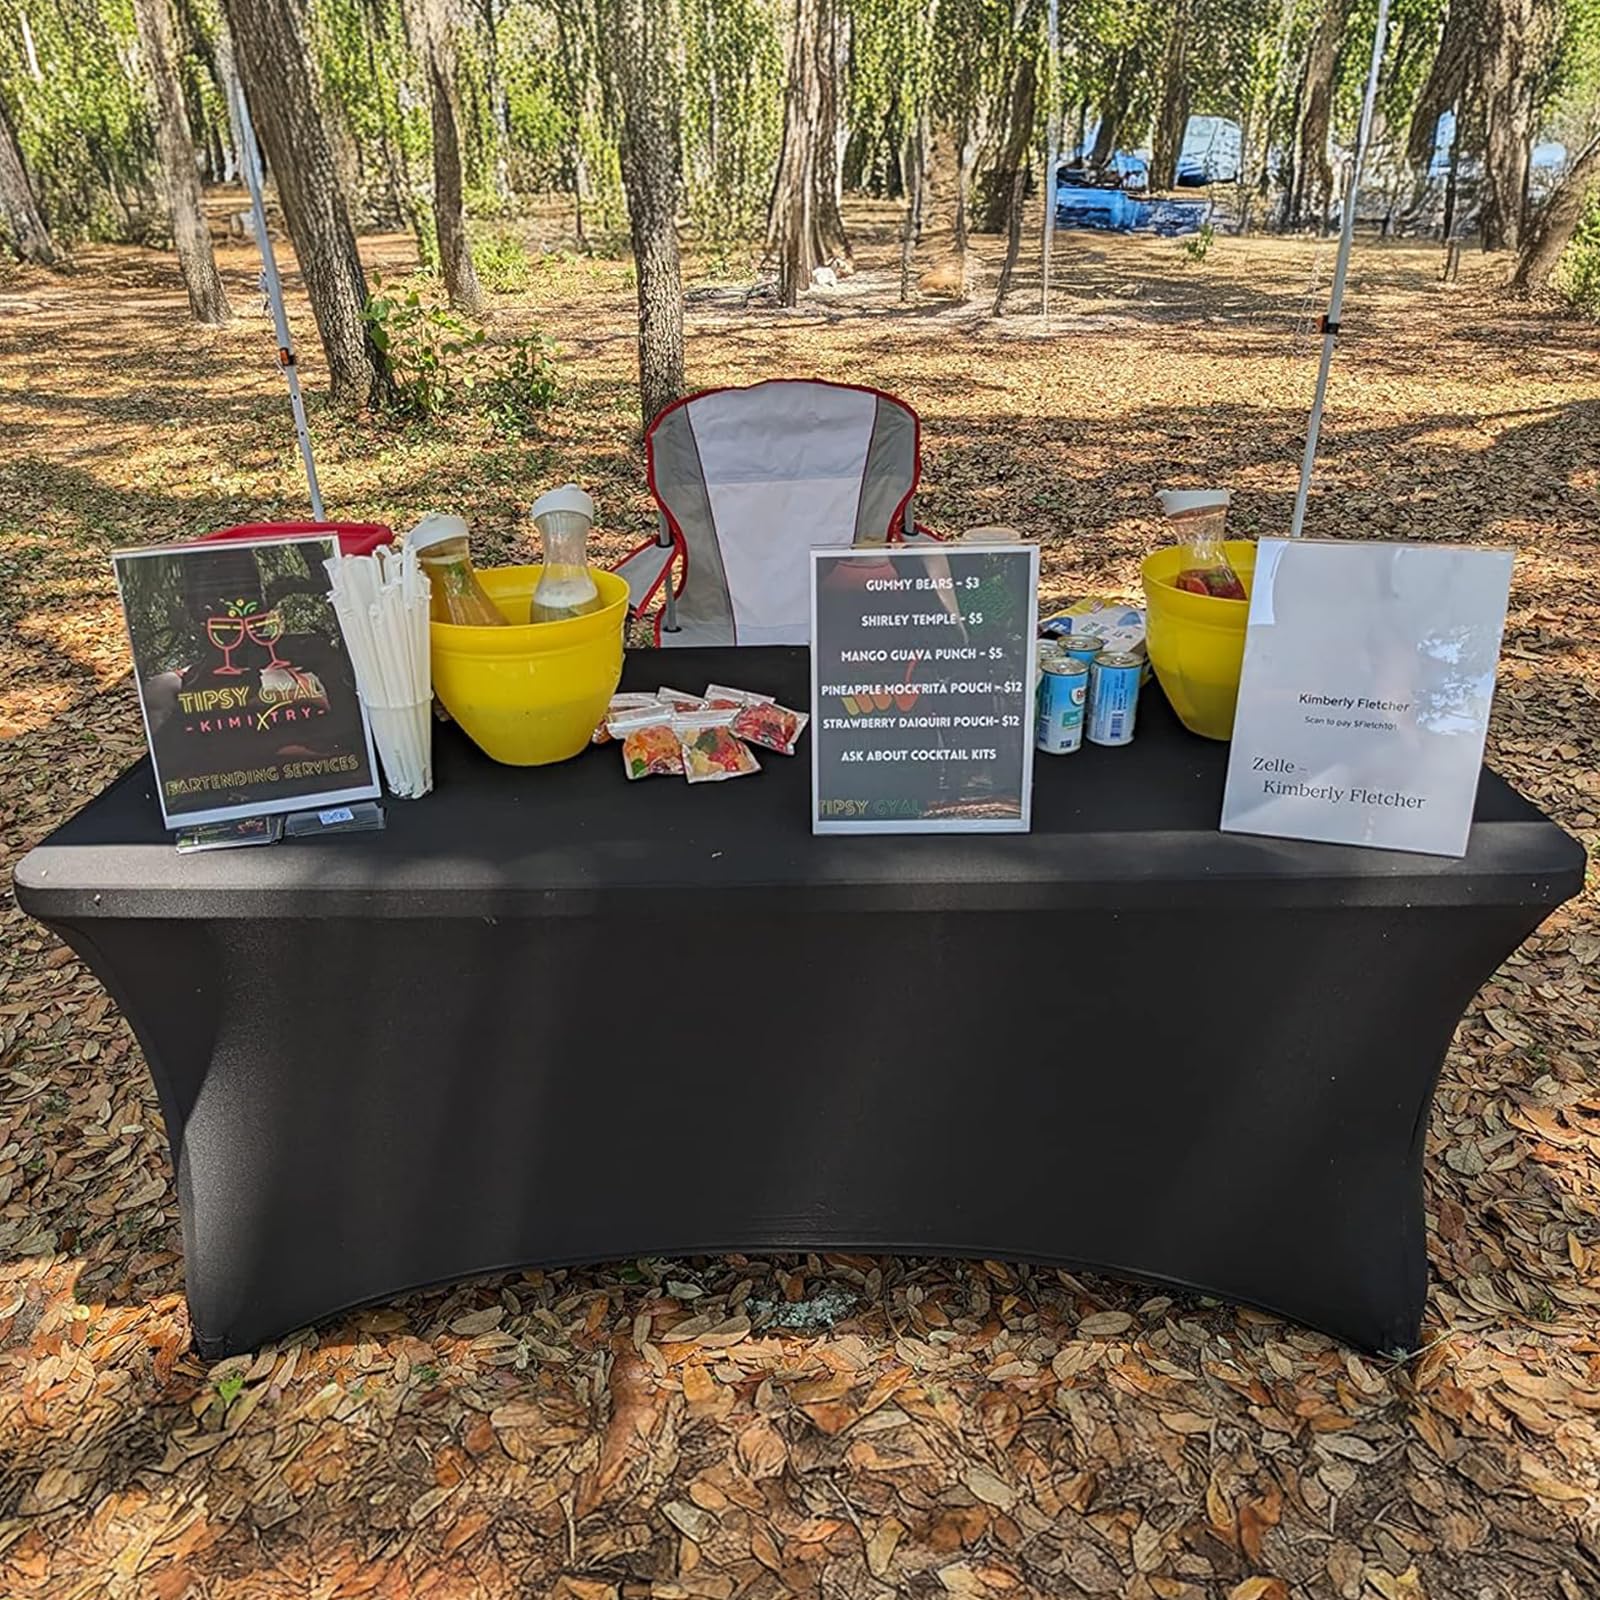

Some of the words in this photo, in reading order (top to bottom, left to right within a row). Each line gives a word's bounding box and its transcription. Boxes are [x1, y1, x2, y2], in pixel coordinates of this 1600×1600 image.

[866, 579, 912, 591] GUMMY
[916, 578, 953, 590] BEARS
[966, 577, 979, 590] $3
[861, 615, 909, 626] SHIRLEY
[912, 613, 956, 625] TEMPLE
[969, 613, 983, 624] $5
[841, 650, 887, 662] MANGO
[891, 649, 932, 660] GUAVA
[936, 648, 976, 659] PUNCH
[989, 647, 1002, 659] $5
[821, 684, 881, 696] PINEAPPLE
[884, 683, 947, 695] MOCK'RITA
[951, 683, 992, 694] POUCH
[1004, 681, 1022, 694] $12
[177, 685, 250, 714] TIPSY
[258, 679, 324, 704] GYAL
[1299, 693, 1354, 709] Kimberly
[1357, 698, 1410, 712] Fletcher
[823, 718, 897, 729] STRAWBERRY
[899, 717, 950, 729] DAIQUIRI
[1002, 715, 1020, 727] $12
[1305, 715, 1324, 724] Scan
[1326, 718, 1335, 726] to
[1336, 720, 1351, 728] pay
[841, 751, 863, 762] ASK
[867, 750, 908, 761] ABOUT
[911, 750, 969, 760] COCKTAIL
[972, 749, 996, 759] KITS
[1252, 757, 1295, 773] Zelle
[164, 766, 279, 797] BARTENDING
[282, 754, 359, 779] SERVICES
[1263, 780, 1345, 804] Kimberly
[1349, 788, 1427, 809] Fletcher
